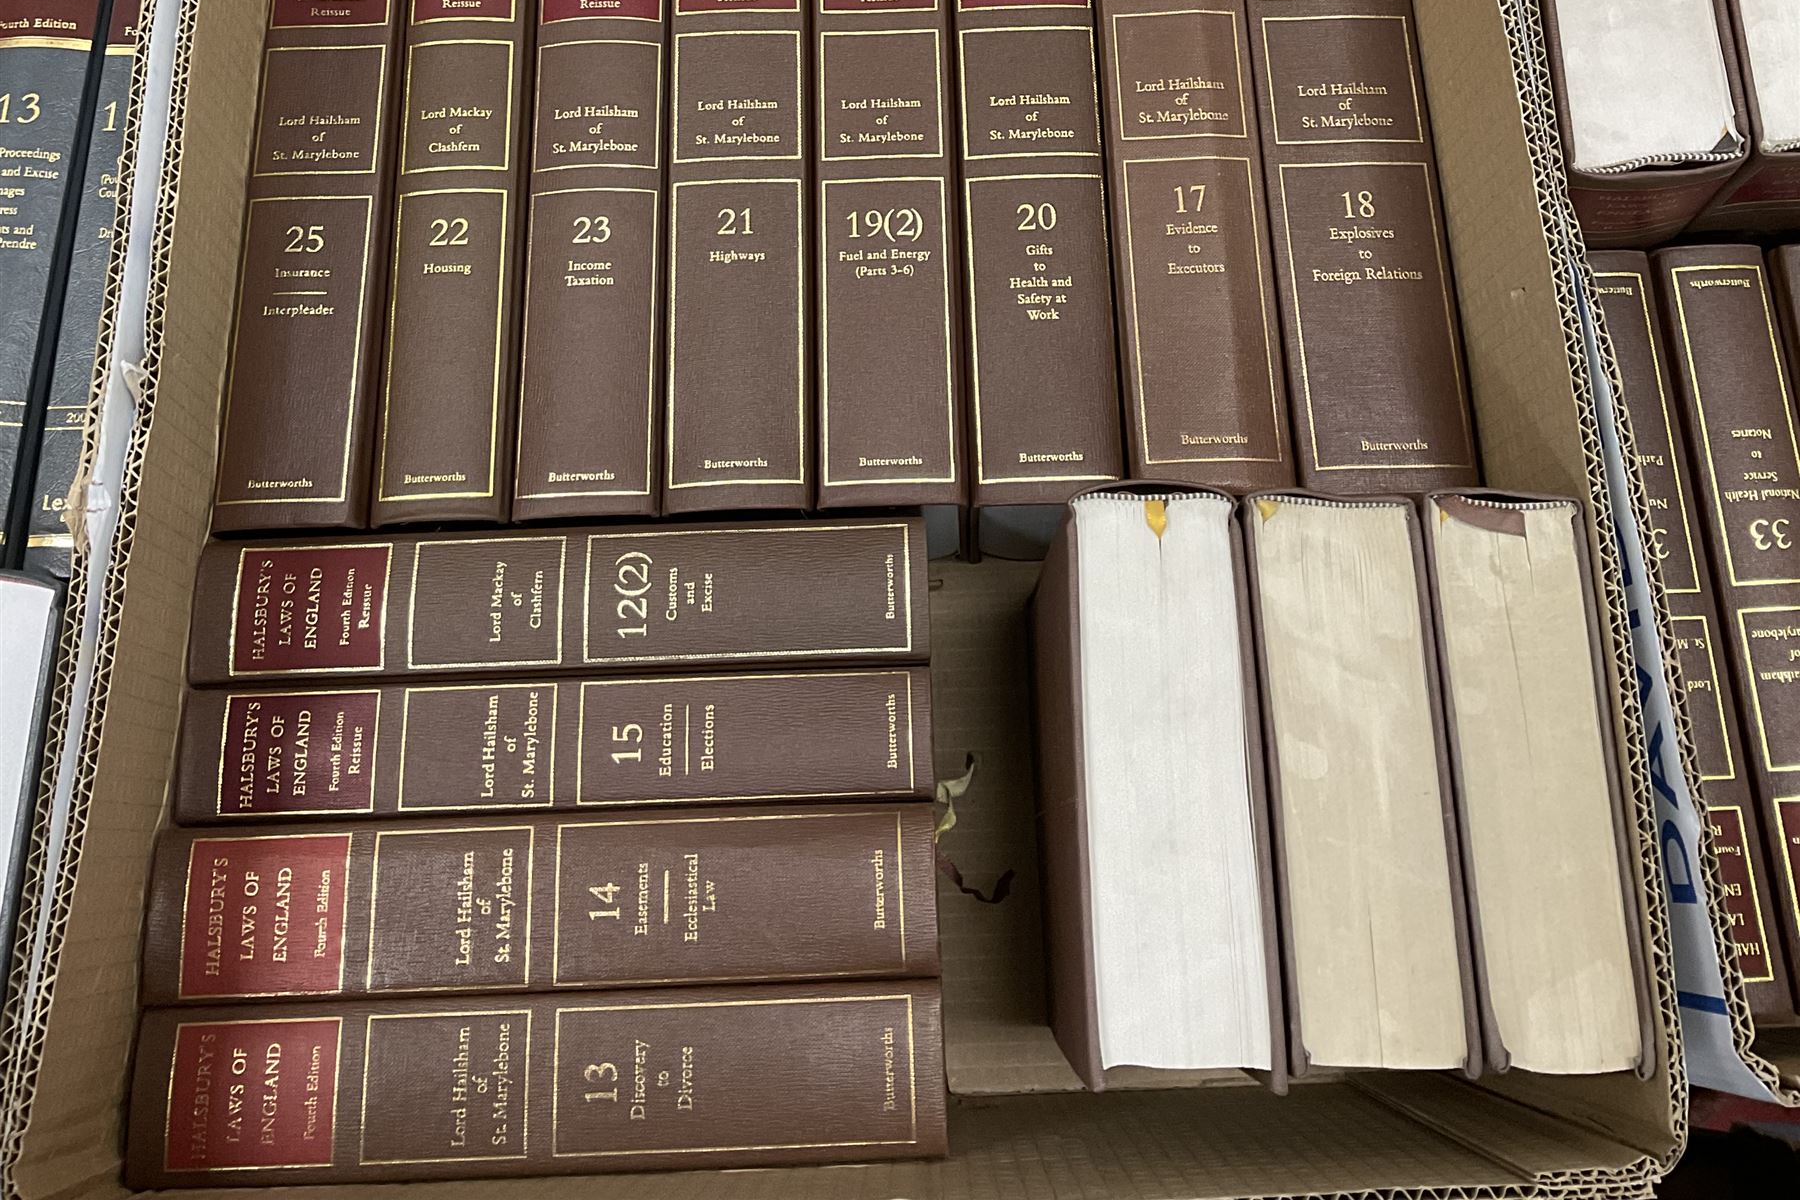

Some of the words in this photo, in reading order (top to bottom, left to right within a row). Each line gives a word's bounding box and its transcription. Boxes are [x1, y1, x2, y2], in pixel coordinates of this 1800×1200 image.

[32, 18, 78, 30] Edition
[989, 94, 1017, 107] Lord
[1019, 93, 1071, 105] Hailsham
[421, 107, 446, 120] Lord
[449, 106, 493, 120] Mackay
[1024, 110, 1040, 122] of
[448, 123, 464, 135] of
[989, 129, 1005, 141] St.
[1008, 127, 1075, 141] Marylebone
[428, 140, 480, 153] Clashfern
[1, 166, 22, 178] and
[23, 166, 60, 180] Excise
[1174, 185, 1205, 213] 17
[1342, 191, 1374, 218] 18
[718, 208, 753, 234] 21
[847, 208, 922, 242] 19(2)
[1017, 203, 1056, 230] 20
[430, 218, 468, 245] 22
[573, 216, 610, 243] 23
[1165, 221, 1219, 236] Evidence
[1329, 226, 1394, 243] Explosives
[285, 226, 323, 252] 25
[709, 249, 766, 264] Highways
[839, 249, 864, 262] Fuel
[866, 248, 888, 260] and
[890, 248, 931, 262] Energy
[1025, 243, 1054, 256] Gifts
[1187, 244, 1201, 254] to
[1358, 249, 1373, 260] to
[275, 268, 331, 278] Insurance
[423, 262, 472, 275] Housing
[567, 260, 612, 272] Income
[855, 265, 887, 279] (Parts
[890, 264, 915, 277] 3-6)
[1033, 262, 1047, 272] to
[1167, 262, 1226, 275] Executors
[564, 273, 614, 287] Taxation
[1009, 276, 1049, 289] Health
[1051, 275, 1073, 287] and
[1312, 268, 1362, 285] Foreign
[1364, 266, 1423, 280] Relations
[1689, 278, 1751, 290] Butterworths
[1017, 292, 1053, 306] Safety
[1055, 294, 1067, 304] at
[263, 303, 335, 318] Interpleader
[1026, 307, 1060, 321] Work
[1730, 428, 1773, 440] Notaries
[1018, 450, 1084, 463] Butterworths
[1750, 450, 1762, 459] to
[403, 471, 466, 484] Butterworths
[1743, 471, 1779, 482] Service
[1724, 489, 1759, 503] Health
[1750, 519, 1791, 550] 33
[283, 573, 297, 594] OF
[615, 552, 652, 638] 12(2)
[665, 567, 678, 621] Customs
[683, 581, 696, 605] and
[701, 573, 713, 613] Excise
[253, 560, 273, 659] HALSBURY'S
[305, 568, 322, 648] ENGLAND
[278, 600, 294, 646] LAWS
[270, 715, 285, 740] OF
[885, 693, 898, 769] Butterworths
[611, 724, 642, 763] 15
[658, 703, 673, 777] Education
[700, 704, 715, 771] Elections
[240, 703, 260, 808] HALSBURY'S
[293, 711, 311, 795] ENGLAND
[266, 746, 282, 794] LAWS
[589, 883, 620, 920] 14
[634, 862, 649, 936] Easements
[682, 853, 699, 942] Ecclesiastical
[702, 879, 716, 912] Law
[584, 1063, 617, 1102] 13
[631, 1040, 649, 1119] Discovery
[656, 1070, 670, 1087] to
[677, 1046, 694, 1110] Divorce
